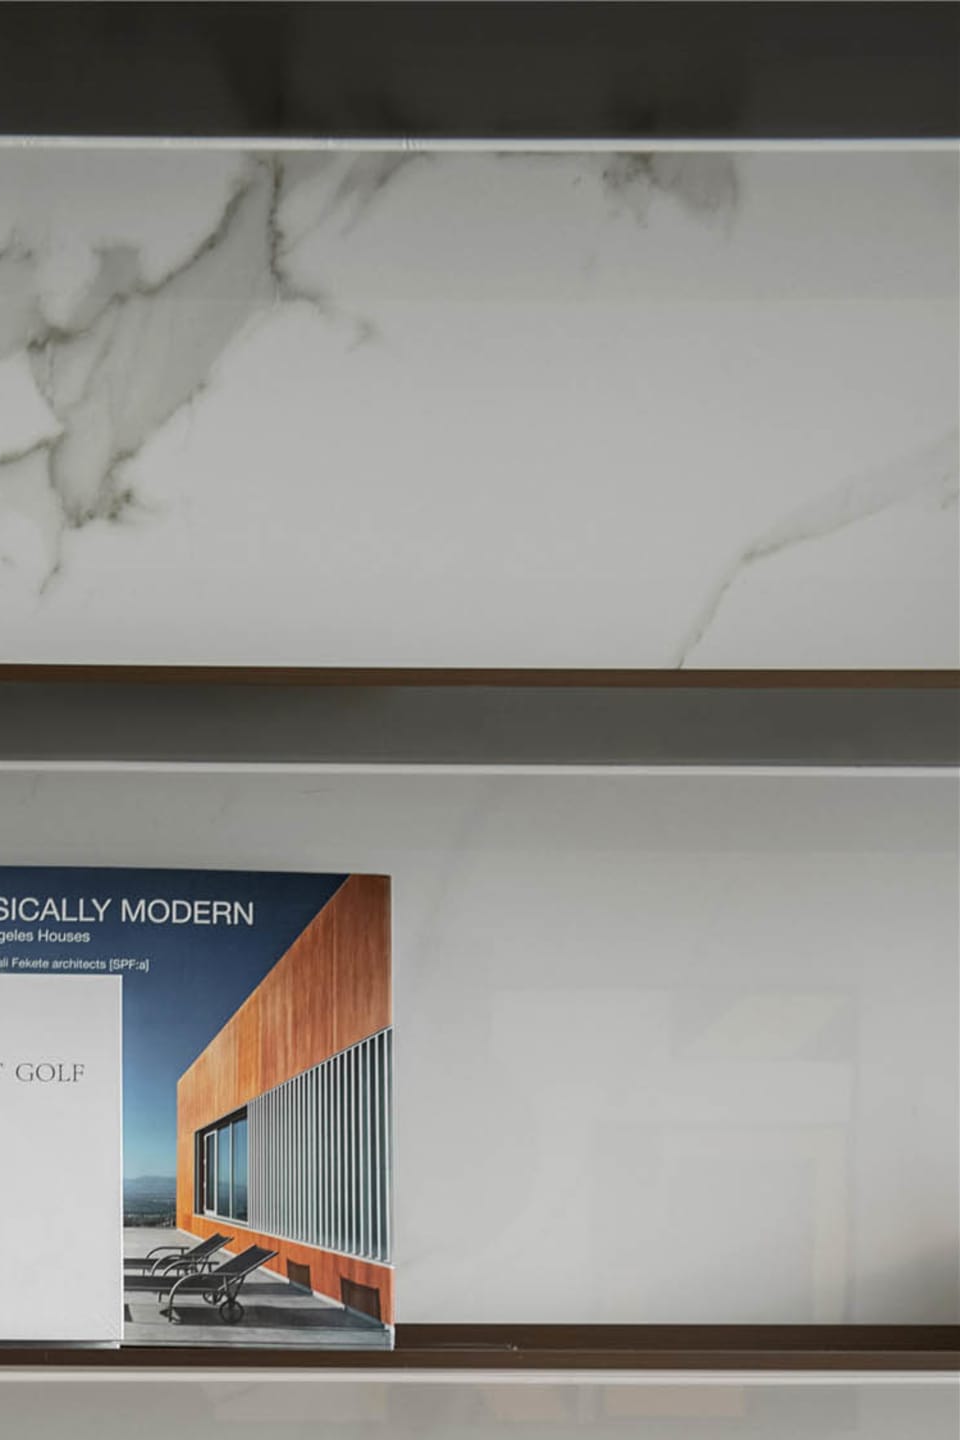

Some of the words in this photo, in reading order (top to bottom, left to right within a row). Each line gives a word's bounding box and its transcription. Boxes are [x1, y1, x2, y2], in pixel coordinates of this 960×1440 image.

[121, 898, 254, 926] MODERN
[38, 928, 91, 943] Houses
[11, 957, 49, 969] Fekete
[51, 957, 106, 970] architects
[109, 958, 149, 973] [SPF:a]
[15, 1062, 86, 1083] GOLF
